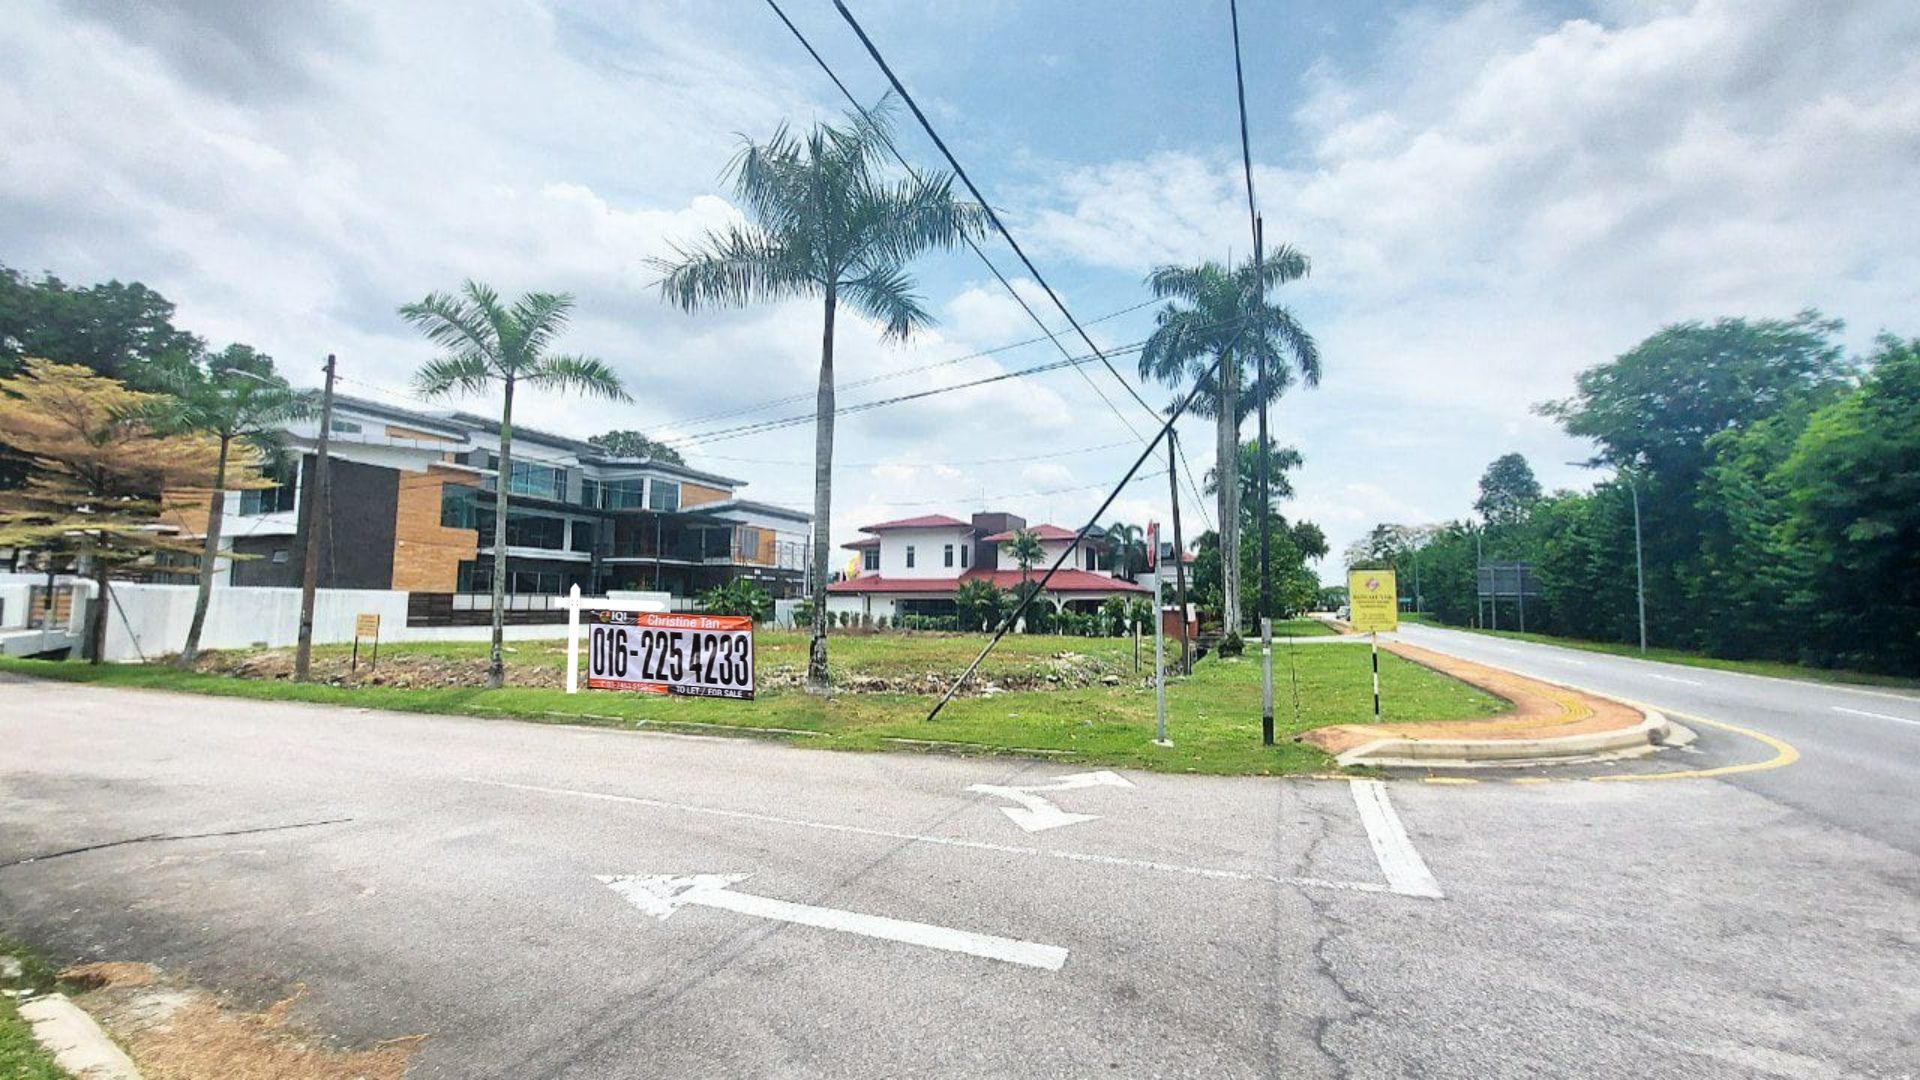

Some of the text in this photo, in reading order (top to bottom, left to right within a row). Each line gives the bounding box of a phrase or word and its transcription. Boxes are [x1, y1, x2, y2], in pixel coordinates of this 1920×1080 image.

[611, 611, 627, 621] IQI
[647, 614, 697, 628] Christine
[701, 617, 720, 629] Tan
[593, 627, 749, 687] 016-225 4233
[686, 686, 700, 695] LET
[707, 687, 722, 696] FOR
[724, 689, 743, 698] SALE
